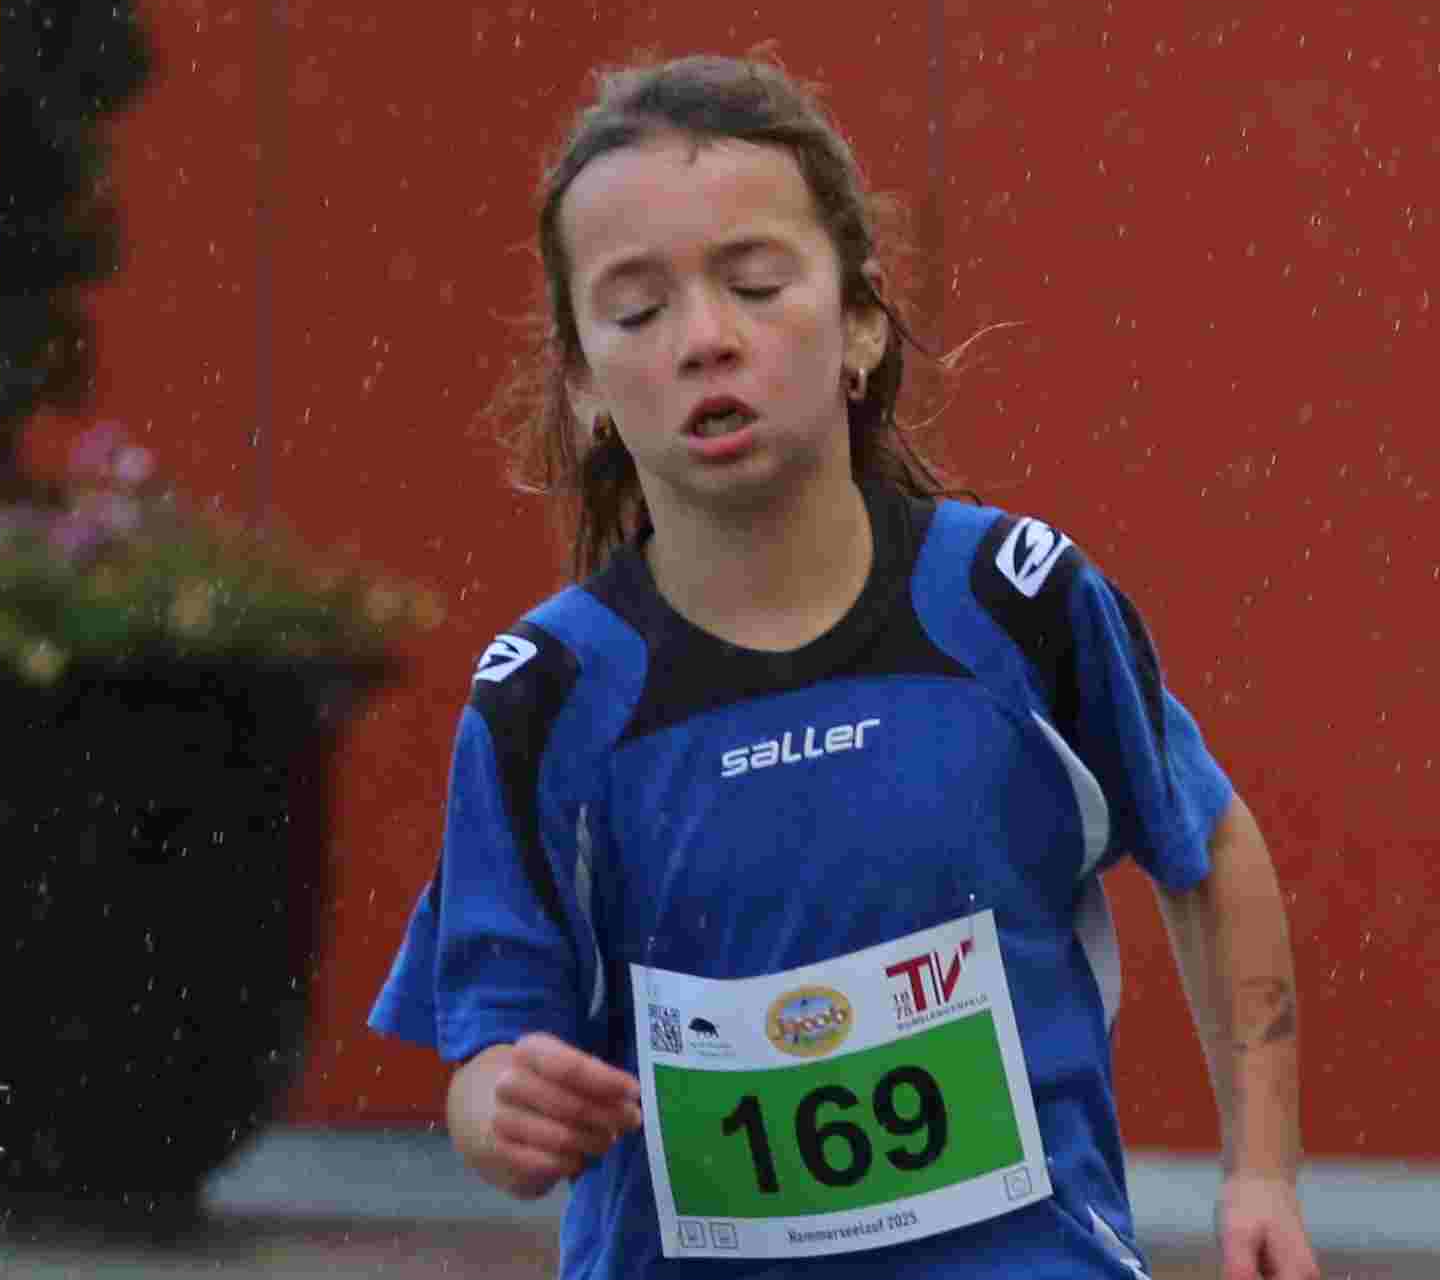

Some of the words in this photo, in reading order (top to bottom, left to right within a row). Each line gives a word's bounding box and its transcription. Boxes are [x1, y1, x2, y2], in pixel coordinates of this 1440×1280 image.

[720, 718, 880, 777] saller
[885, 936, 974, 1012] TV
[720, 1065, 948, 1194] 169
